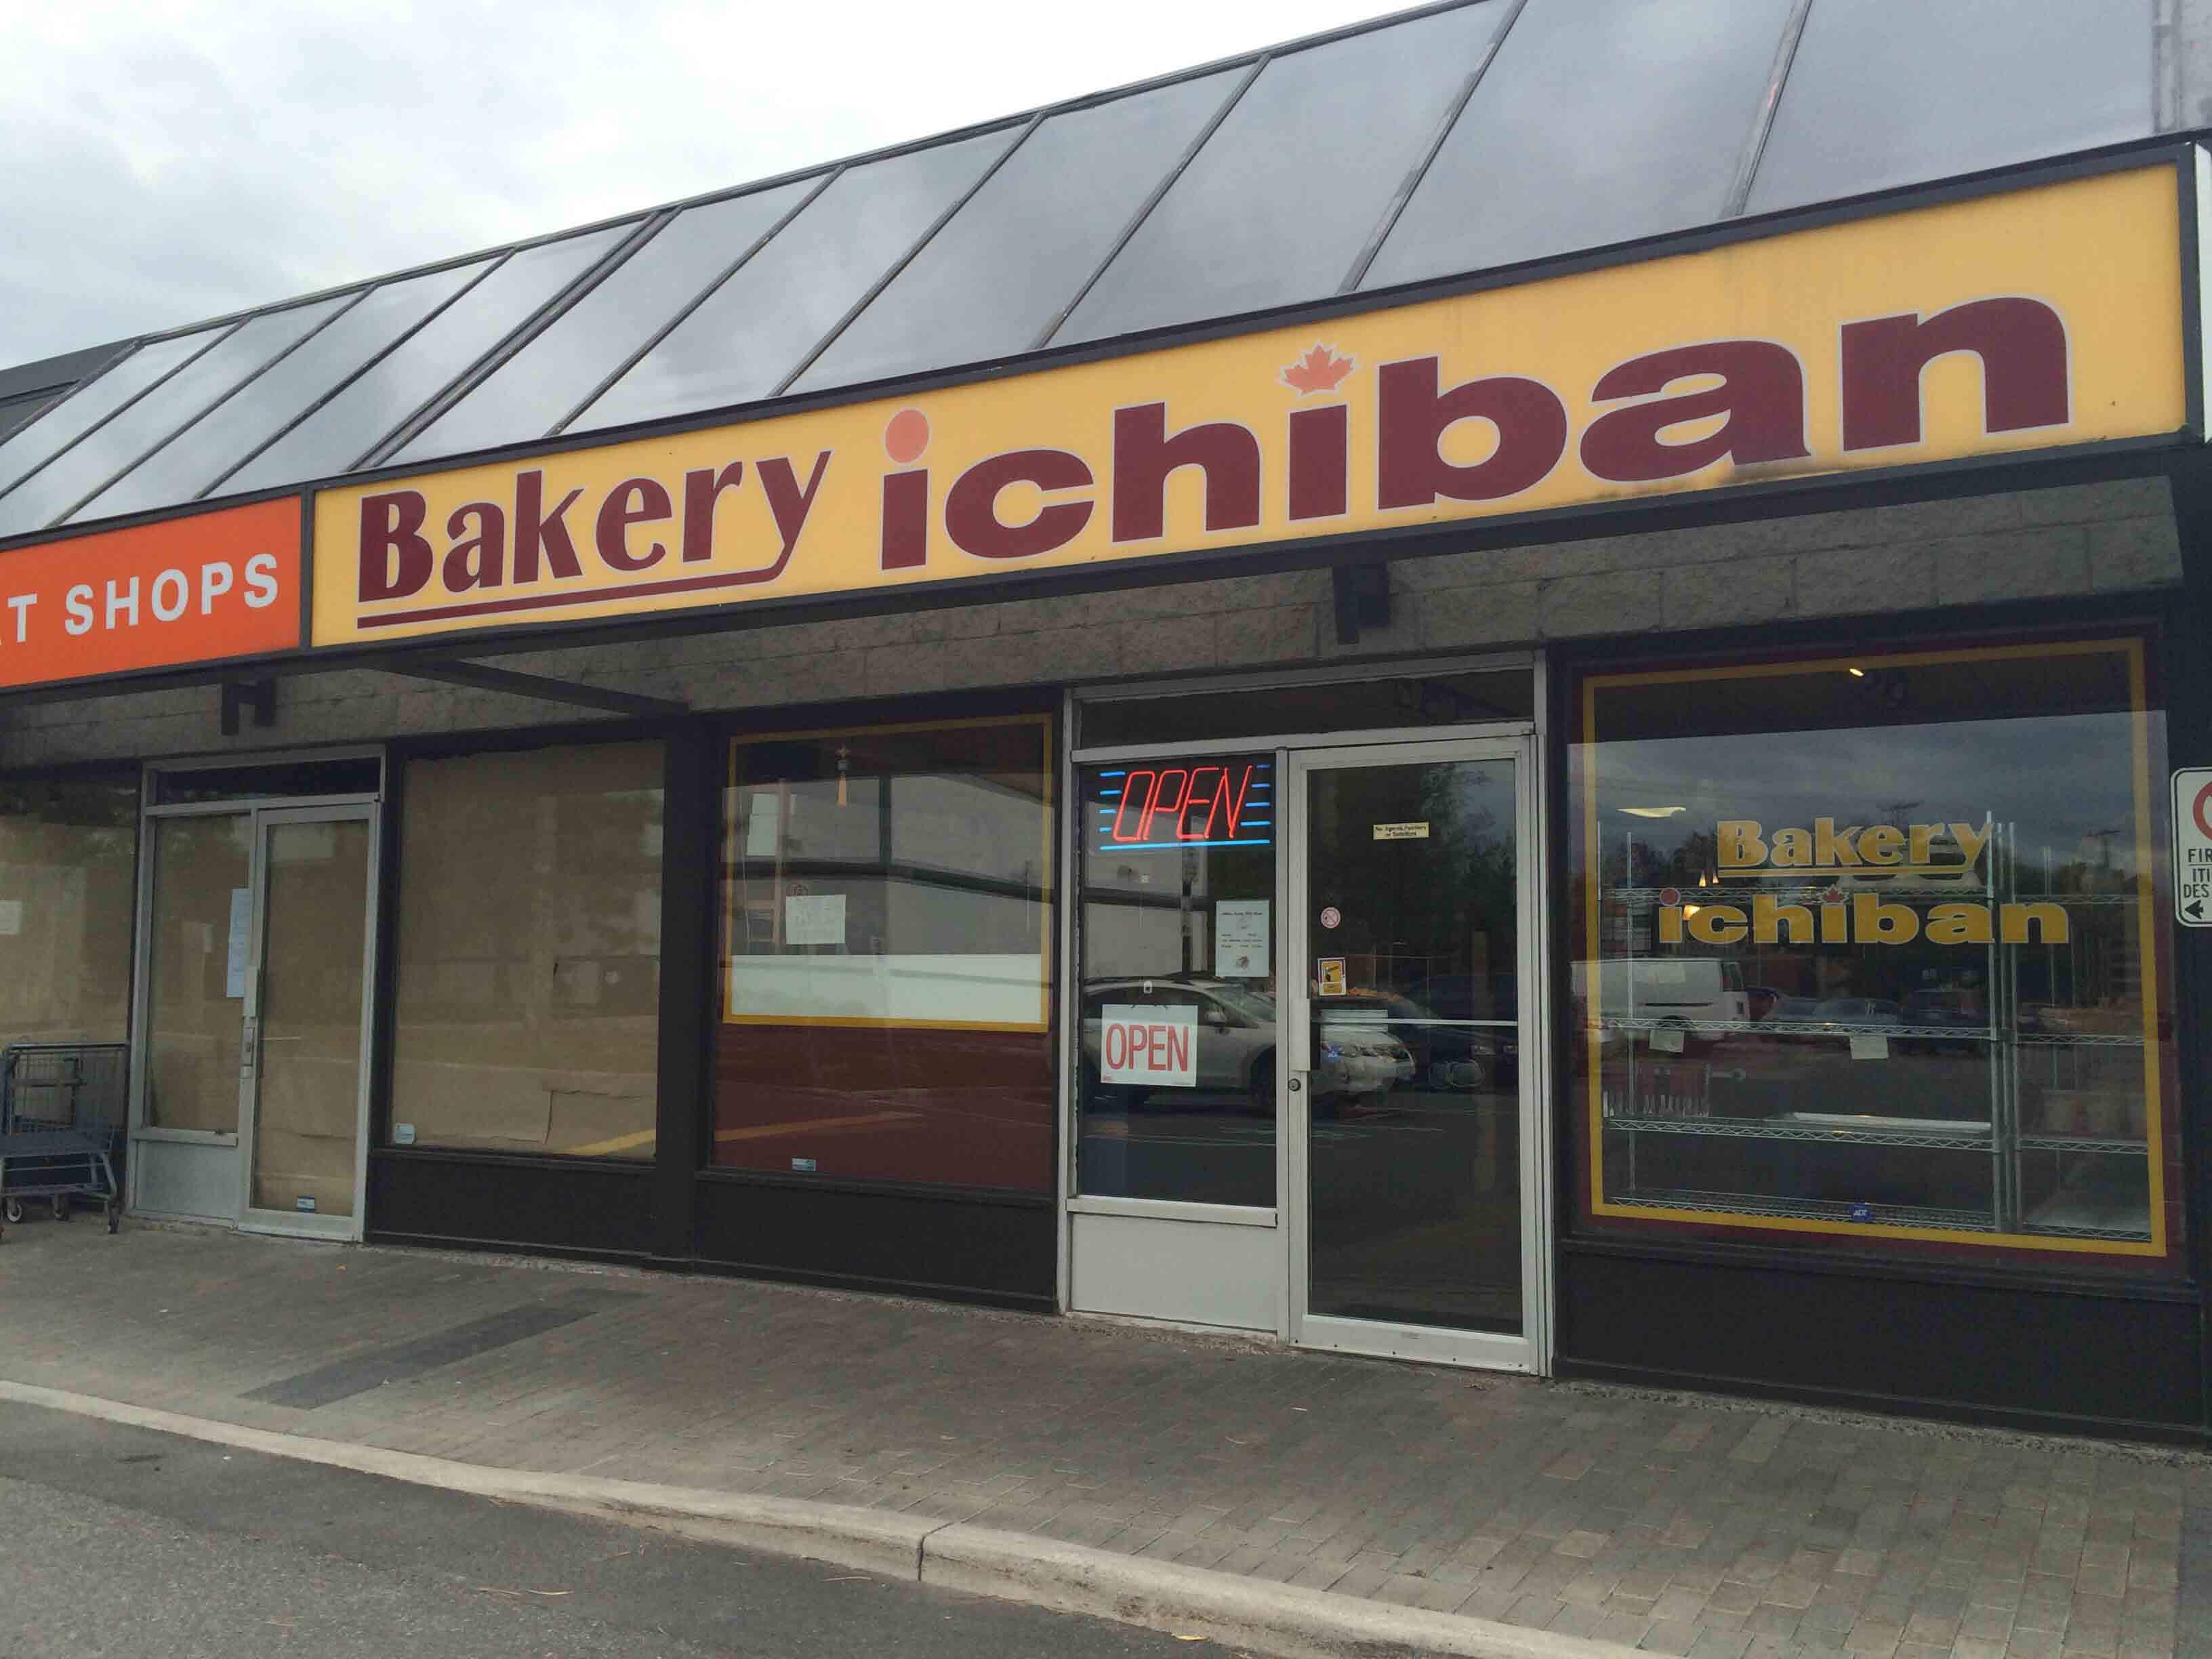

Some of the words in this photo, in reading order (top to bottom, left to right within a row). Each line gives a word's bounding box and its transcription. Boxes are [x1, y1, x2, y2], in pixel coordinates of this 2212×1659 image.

[356, 449, 834, 605] Bakery
[880, 295, 2071, 572] ichiban
[64, 553, 279, 636] SHOPS
[1113, 764, 1253, 842] OPEN
[1717, 817, 1994, 876] Bakery
[1658, 886, 2070, 945] ichiban
[2184, 884, 2209, 898] DES
[1105, 1023, 1189, 1072] OPEN
